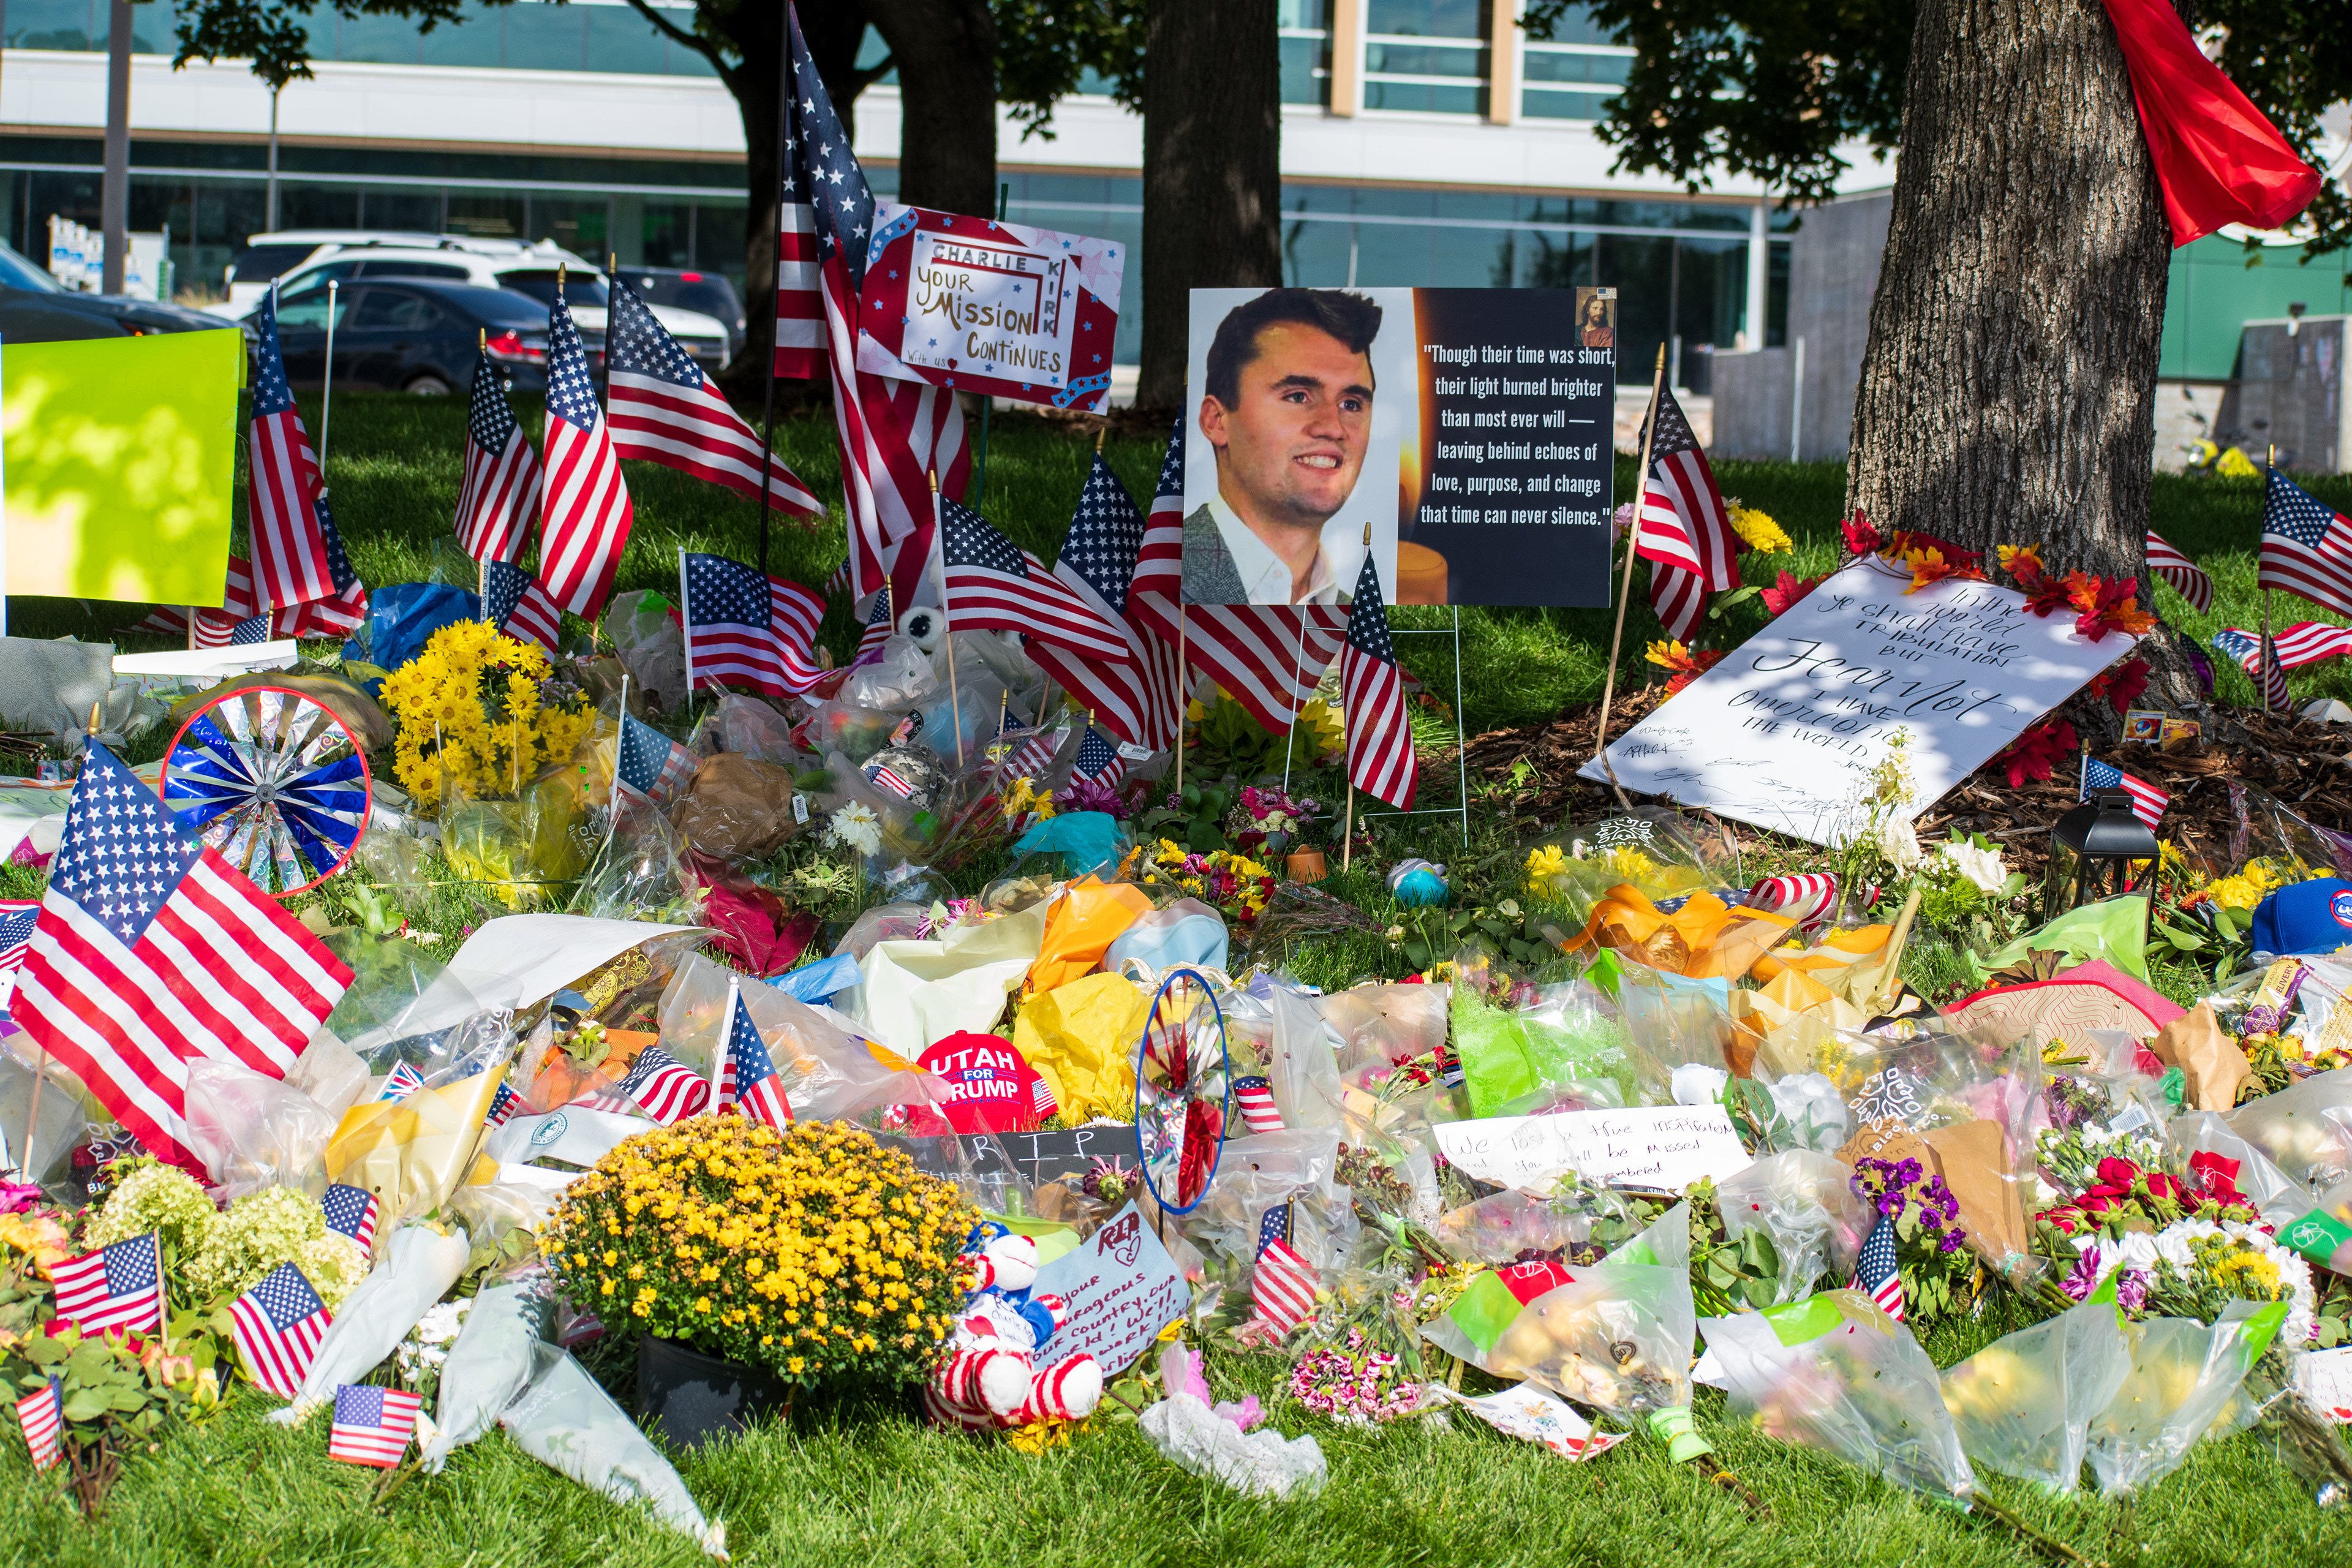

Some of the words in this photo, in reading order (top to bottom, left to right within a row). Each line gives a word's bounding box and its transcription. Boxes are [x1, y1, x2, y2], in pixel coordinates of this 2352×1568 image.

[933, 244, 1027, 271] CHARLIE
[1044, 262, 1060, 334] KIRK
[908, 350, 927, 365] With
[935, 356, 946, 368] us
[1423, 344, 1477, 366] "Though
[1481, 344, 1513, 364] their
[1516, 345, 1545, 363] time
[1549, 348, 1574, 364] was
[1577, 345, 1616, 366] short,
[1435, 376, 1467, 396] their
[1469, 376, 1499, 398] light
[1502, 377, 1547, 396] burned
[1551, 378, 1603, 399] brighter
[1441, 409, 1470, 427] than
[1474, 409, 1507, 427] most
[1510, 413, 1539, 428] ever
[1542, 409, 1565, 428] will
[1438, 440, 1484, 463] leaving
[1487, 441, 1531, 459] behind
[1534, 442, 1580, 461] echoes
[1584, 442, 1597, 461] of
[1431, 472, 1463, 494] love,
[1467, 475, 1523, 495] purpose,
[1526, 473, 1550, 492] and
[1554, 474, 1601, 497] change
[1420, 505, 1448, 522] that
[1450, 505, 1480, 523] time
[1483, 508, 1507, 524] can
[1511, 508, 1548, 524] never
[1551, 506, 1611, 526] silence."
[1983, 596, 2027, 619] the
[1817, 595, 1855, 612] ye
[1861, 604, 1939, 635] shall
[1939, 620, 2029, 658] have
[1919, 602, 2026, 638] world
[1855, 619, 2010, 668] TRIBULATION
[1878, 645, 1940, 662] BUT
[1752, 638, 1895, 694] Fear
[1809, 688, 1831, 701] I
[1836, 696, 1899, 721] HAVE
[1742, 716, 1789, 734] THE
[930, 1047, 1016, 1076] UTAH
[963, 1069, 993, 1080] FOR
[941, 1080, 1019, 1105] RUMP
[1446, 1134, 1489, 1156] We
[1607, 1143, 1629, 1159] be
